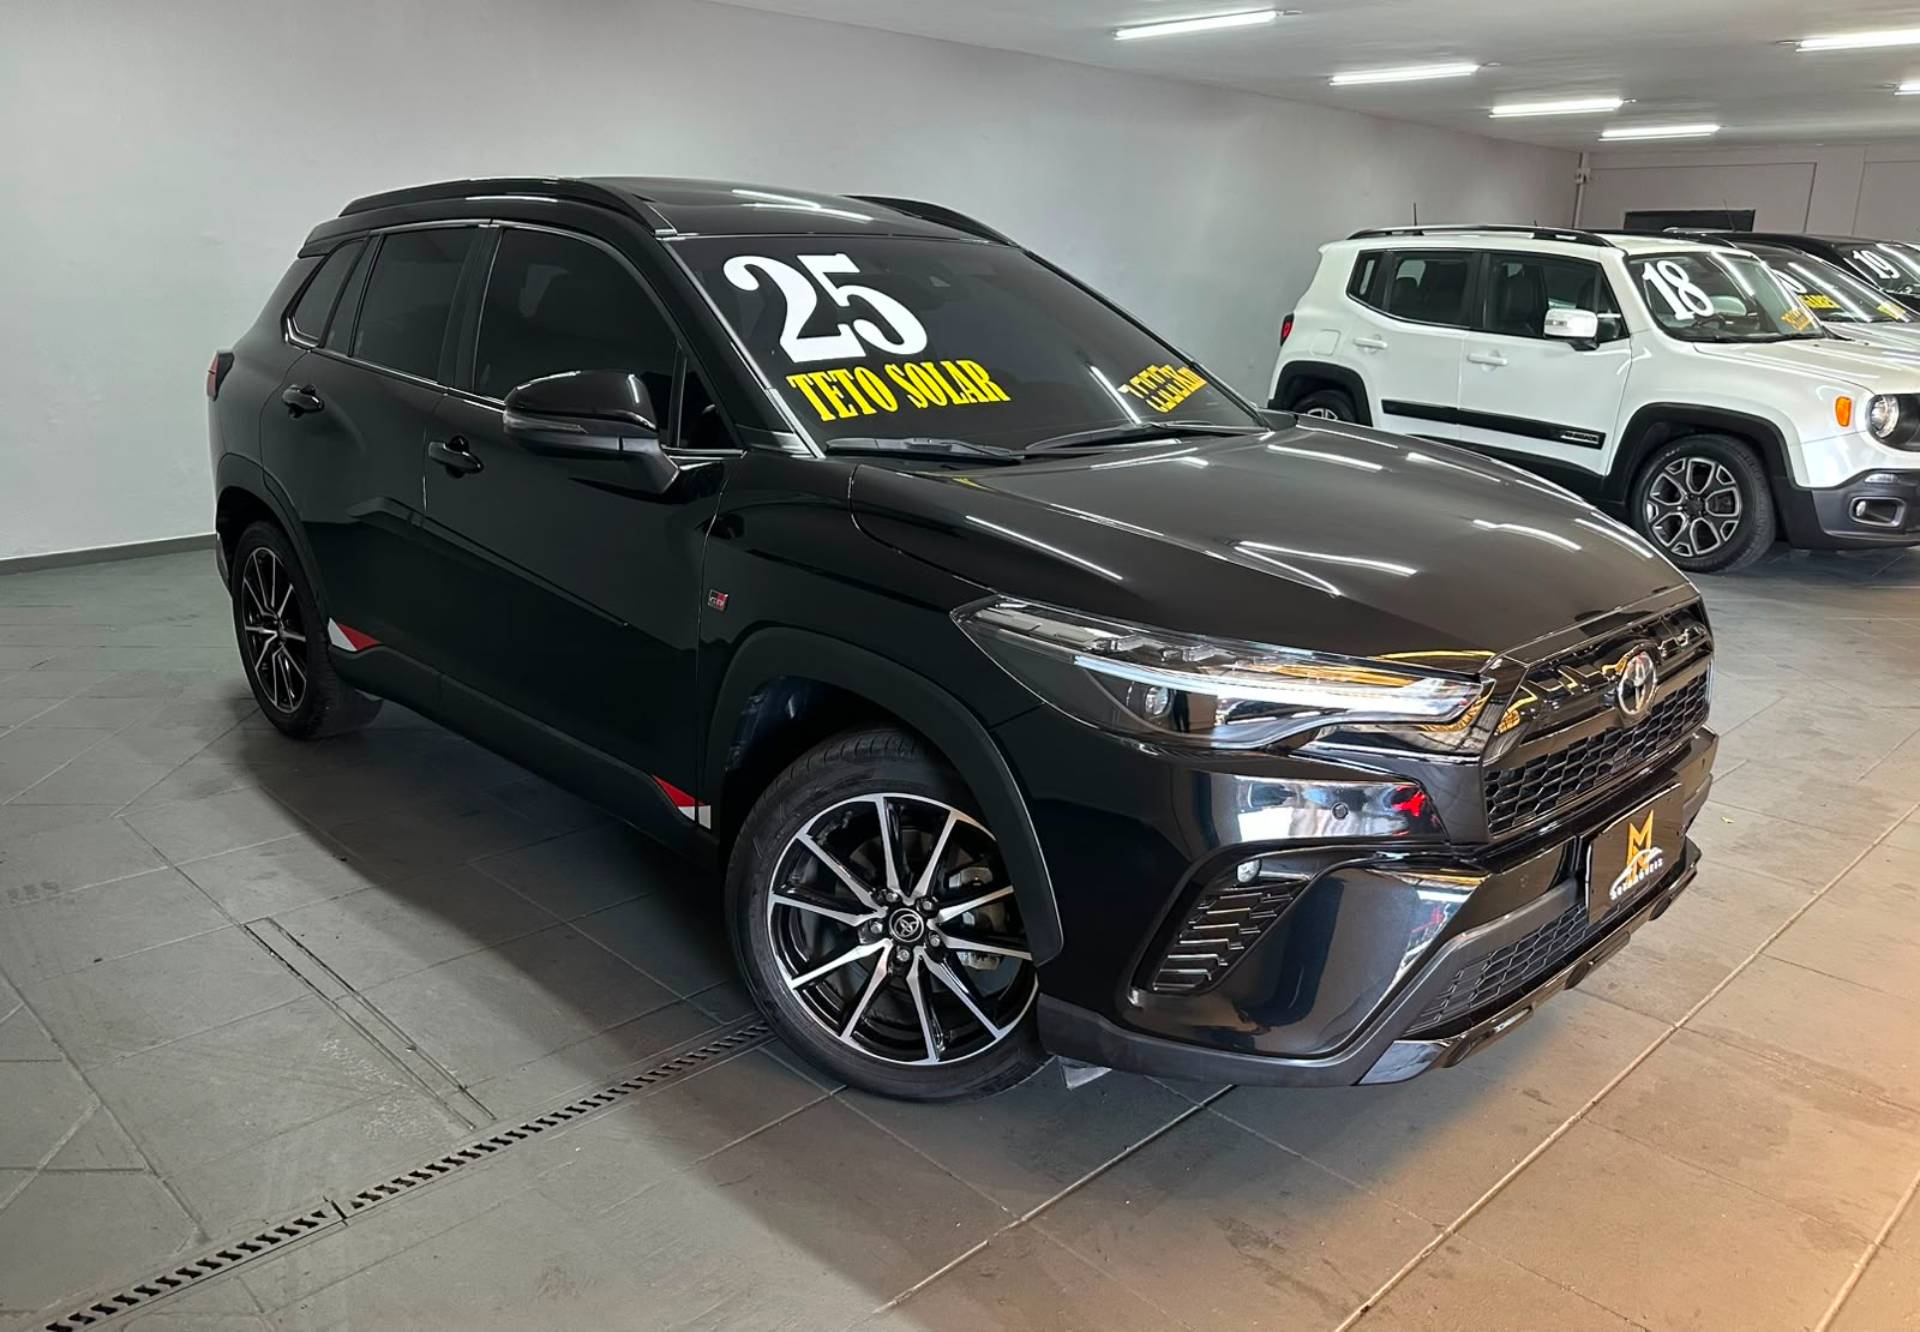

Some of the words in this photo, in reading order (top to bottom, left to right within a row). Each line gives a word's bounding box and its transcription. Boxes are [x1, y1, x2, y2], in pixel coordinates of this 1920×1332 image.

[1642, 260, 1715, 320] 18
[1852, 250, 1900, 279] 19
[723, 253, 928, 363] 25
[787, 366, 899, 421] TETO
[885, 359, 1011, 409] SOLAR
